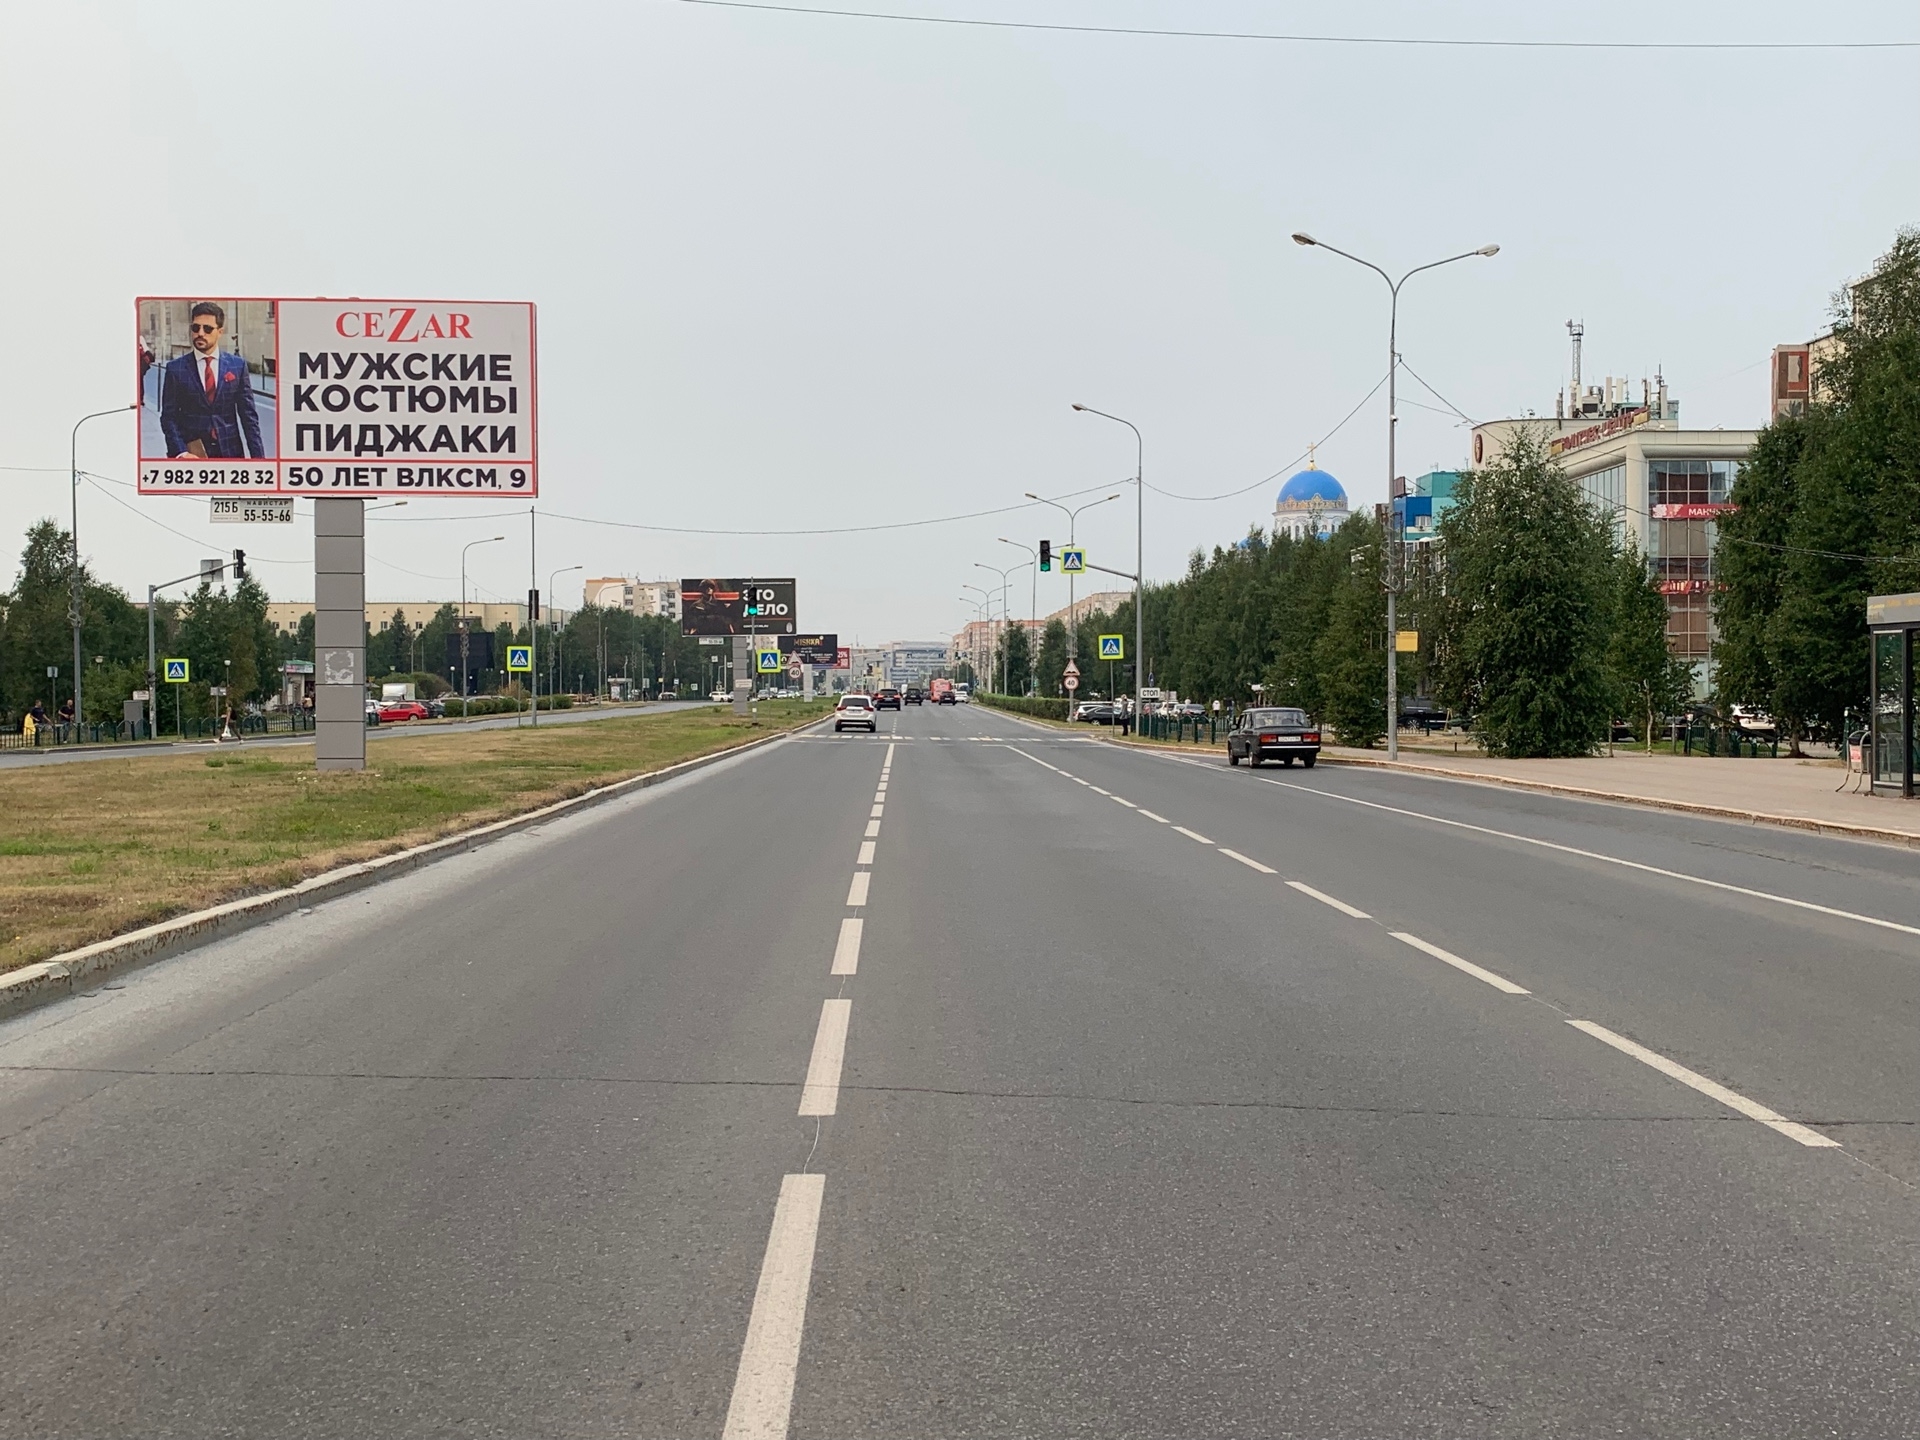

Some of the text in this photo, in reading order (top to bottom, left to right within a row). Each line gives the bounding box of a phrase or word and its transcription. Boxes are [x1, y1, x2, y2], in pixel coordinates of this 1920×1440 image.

[299, 351, 512, 382] МУЖСКИЕ
[293, 384, 518, 414] КОСТЮМЫ
[295, 423, 517, 457] ПИДЖАКИ
[142, 469, 274, 484] +7 982 921 28 32
[287, 466, 527, 490] 50 ЛЕТ ВЛКСМ, 9
[243, 509, 291, 521] 55-55-66
[1142, 689, 1159, 697] СТОП
